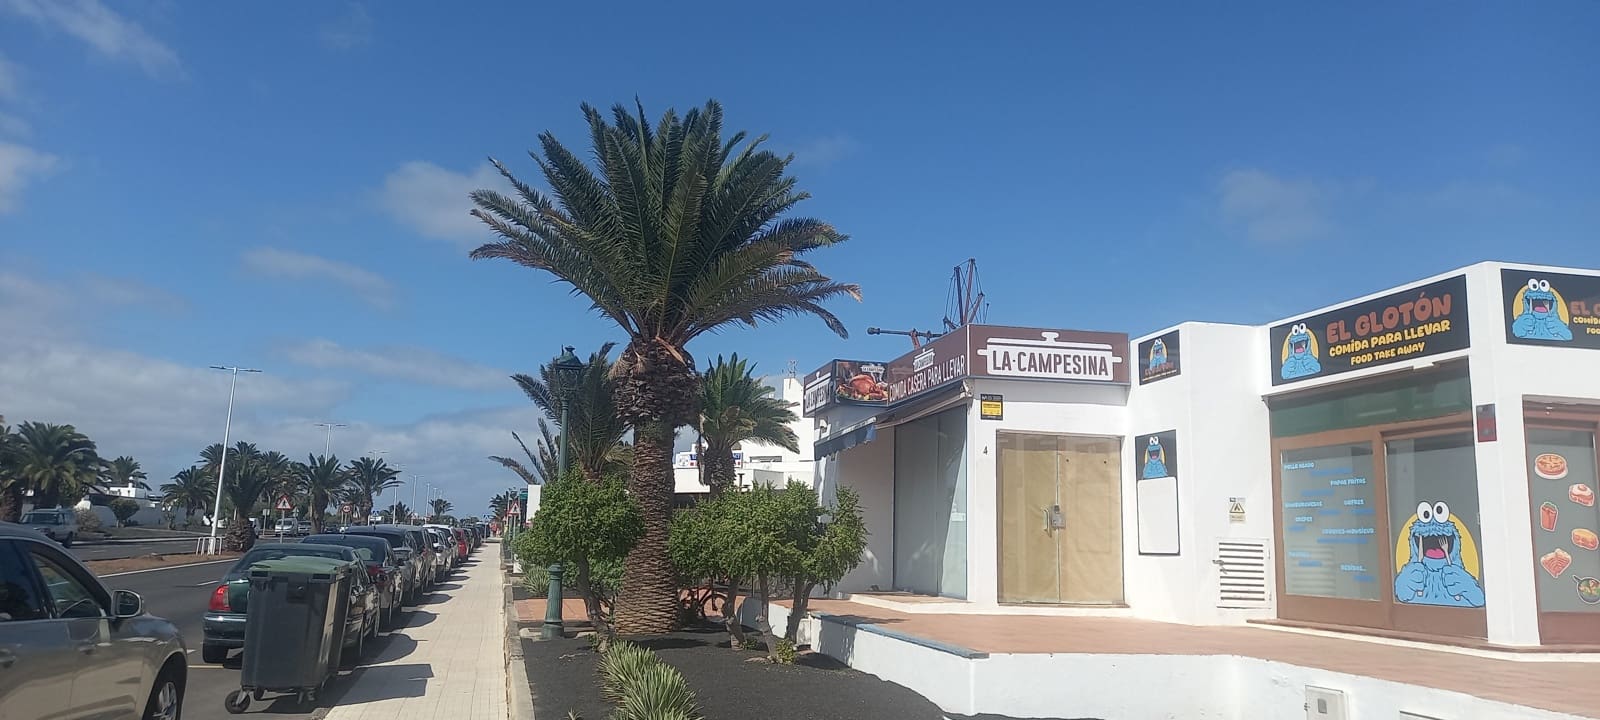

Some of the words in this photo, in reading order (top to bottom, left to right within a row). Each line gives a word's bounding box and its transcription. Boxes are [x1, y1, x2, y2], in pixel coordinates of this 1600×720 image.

[1326, 320, 1351, 344] EL
[1355, 292, 1452, 337] GLOTÓN
[1570, 301, 1590, 316] EL
[1370, 331, 1402, 348] PARA
[1404, 319, 1451, 340] LLEVAR
[1350, 353, 1373, 366] FOOD
[1374, 347, 1396, 360] TAKE
[1397, 342, 1426, 355] AWAY
[889, 379, 907, 402] COMIDA
[907, 370, 928, 395] CASERA
[928, 364, 942, 388] PARA
[942, 354, 966, 382] LLEVAR
[982, 445, 988, 456] 4
